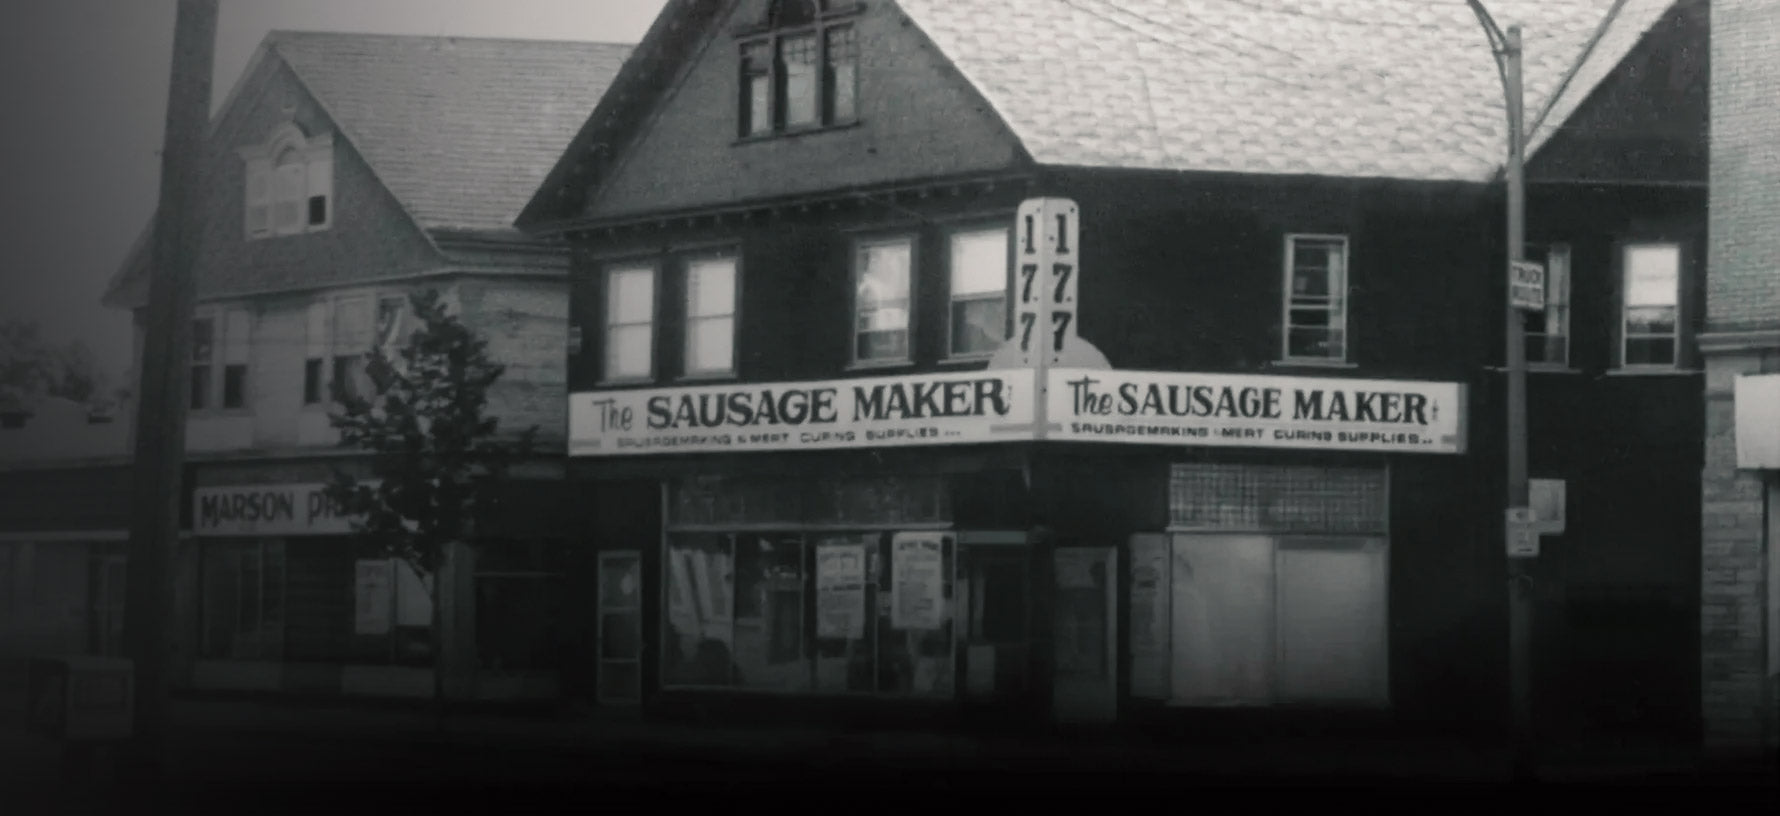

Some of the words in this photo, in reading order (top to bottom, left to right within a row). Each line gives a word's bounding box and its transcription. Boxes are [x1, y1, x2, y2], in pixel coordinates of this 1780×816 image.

[592, 398, 633, 432] The
[647, 388, 838, 428] SAUSAGE
[853, 379, 1010, 421] MAKER
[1067, 375, 1113, 415] The
[1118, 383, 1282, 418] SAUSAGE
[1293, 389, 1428, 426] MAKER
[750, 432, 790, 443] MEAT
[800, 431, 855, 444] CURING
[1072, 423, 1208, 437] SAUSAGEMAKING
[1222, 428, 1264, 439] MEAT
[1274, 429, 1332, 441] CURING
[201, 491, 294, 526] MARSON
